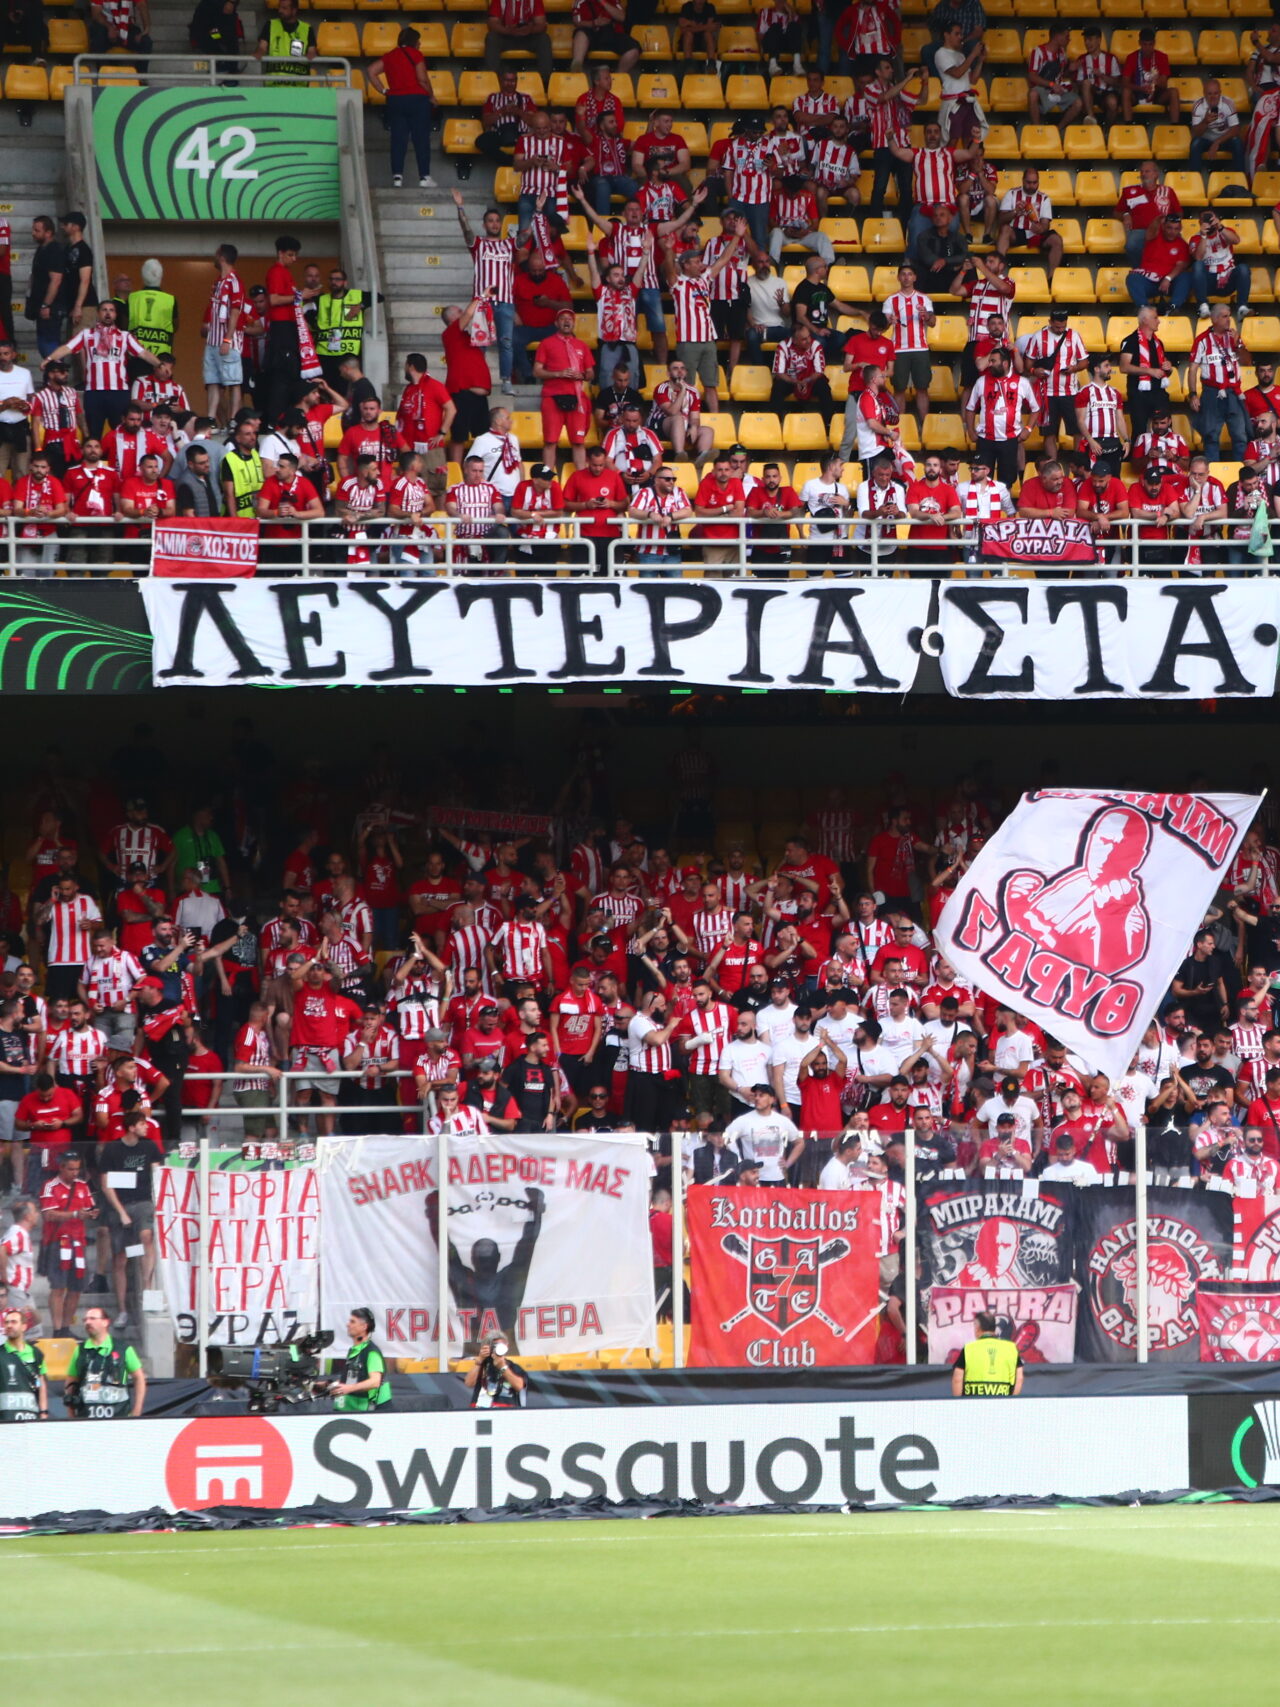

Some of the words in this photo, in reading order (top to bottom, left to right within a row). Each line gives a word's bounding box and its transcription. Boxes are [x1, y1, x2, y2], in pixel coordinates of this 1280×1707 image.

[175, 126, 259, 180] 42
[984, 519, 1094, 545] ΑΡΙΔΑΙΑ
[1012, 539, 1053, 555] ΘΥΡΑ
[1053, 540, 1066, 555] 7
[159, 581, 901, 689] ΛΕΥΤΕΡΙΑ
[943, 583, 1257, 694] ΣΤΑ
[748, 942, 758, 952] 25
[564, 1014, 591, 1035] 45
[155, 1167, 321, 1216] ΑΔΕΡΦΙΑ
[347, 1157, 436, 1207] SHARK
[448, 1155, 556, 1187] ΑΔΕΡΦΕ
[565, 1159, 632, 1200] ΜΑΣ
[710, 1196, 861, 1233] Koridallos
[930, 1193, 1063, 1231] ΜΠΡΑΧΑΜΙ
[160, 1214, 318, 1264] ΚΡΑΤΑΤΕ
[189, 1264, 290, 1314] ΓΕΡΑ
[931, 1289, 1074, 1327] PATRA
[385, 1307, 502, 1343] ΚΡΑΤΑ
[517, 1302, 604, 1341] ΓΕΡΑ
[746, 1338, 817, 1367] Club
[88, 1405, 114, 1418] 100
[313, 1416, 939, 1508] Swissquote
